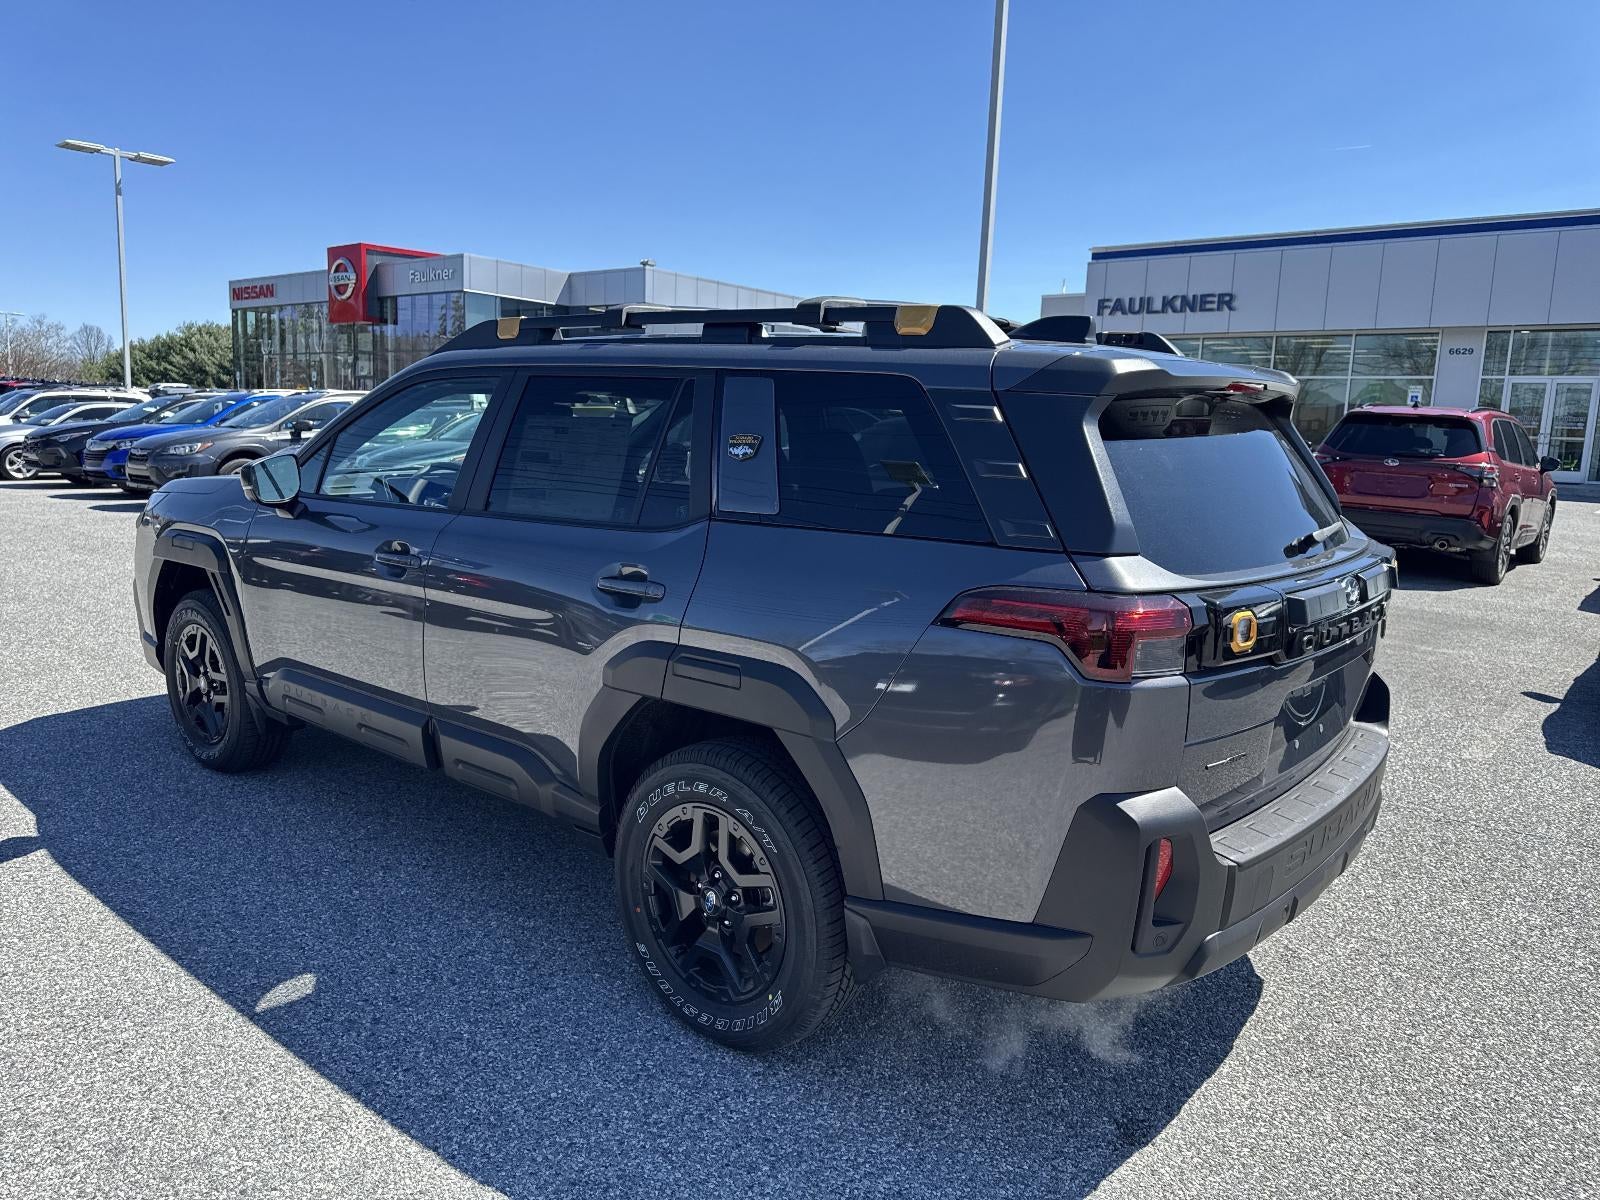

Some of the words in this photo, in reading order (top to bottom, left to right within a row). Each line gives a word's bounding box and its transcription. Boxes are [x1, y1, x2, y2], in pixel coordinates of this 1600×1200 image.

[409, 268, 453, 283] Faulkner
[232, 283, 275, 301] NISSAN
[1096, 293, 1236, 316] FAULKNER
[1448, 347, 1474, 355] 6629
[636, 780, 728, 823] DUELER
[735, 808, 778, 854] A/T
[635, 941, 784, 1032] BRIDGESTONE
